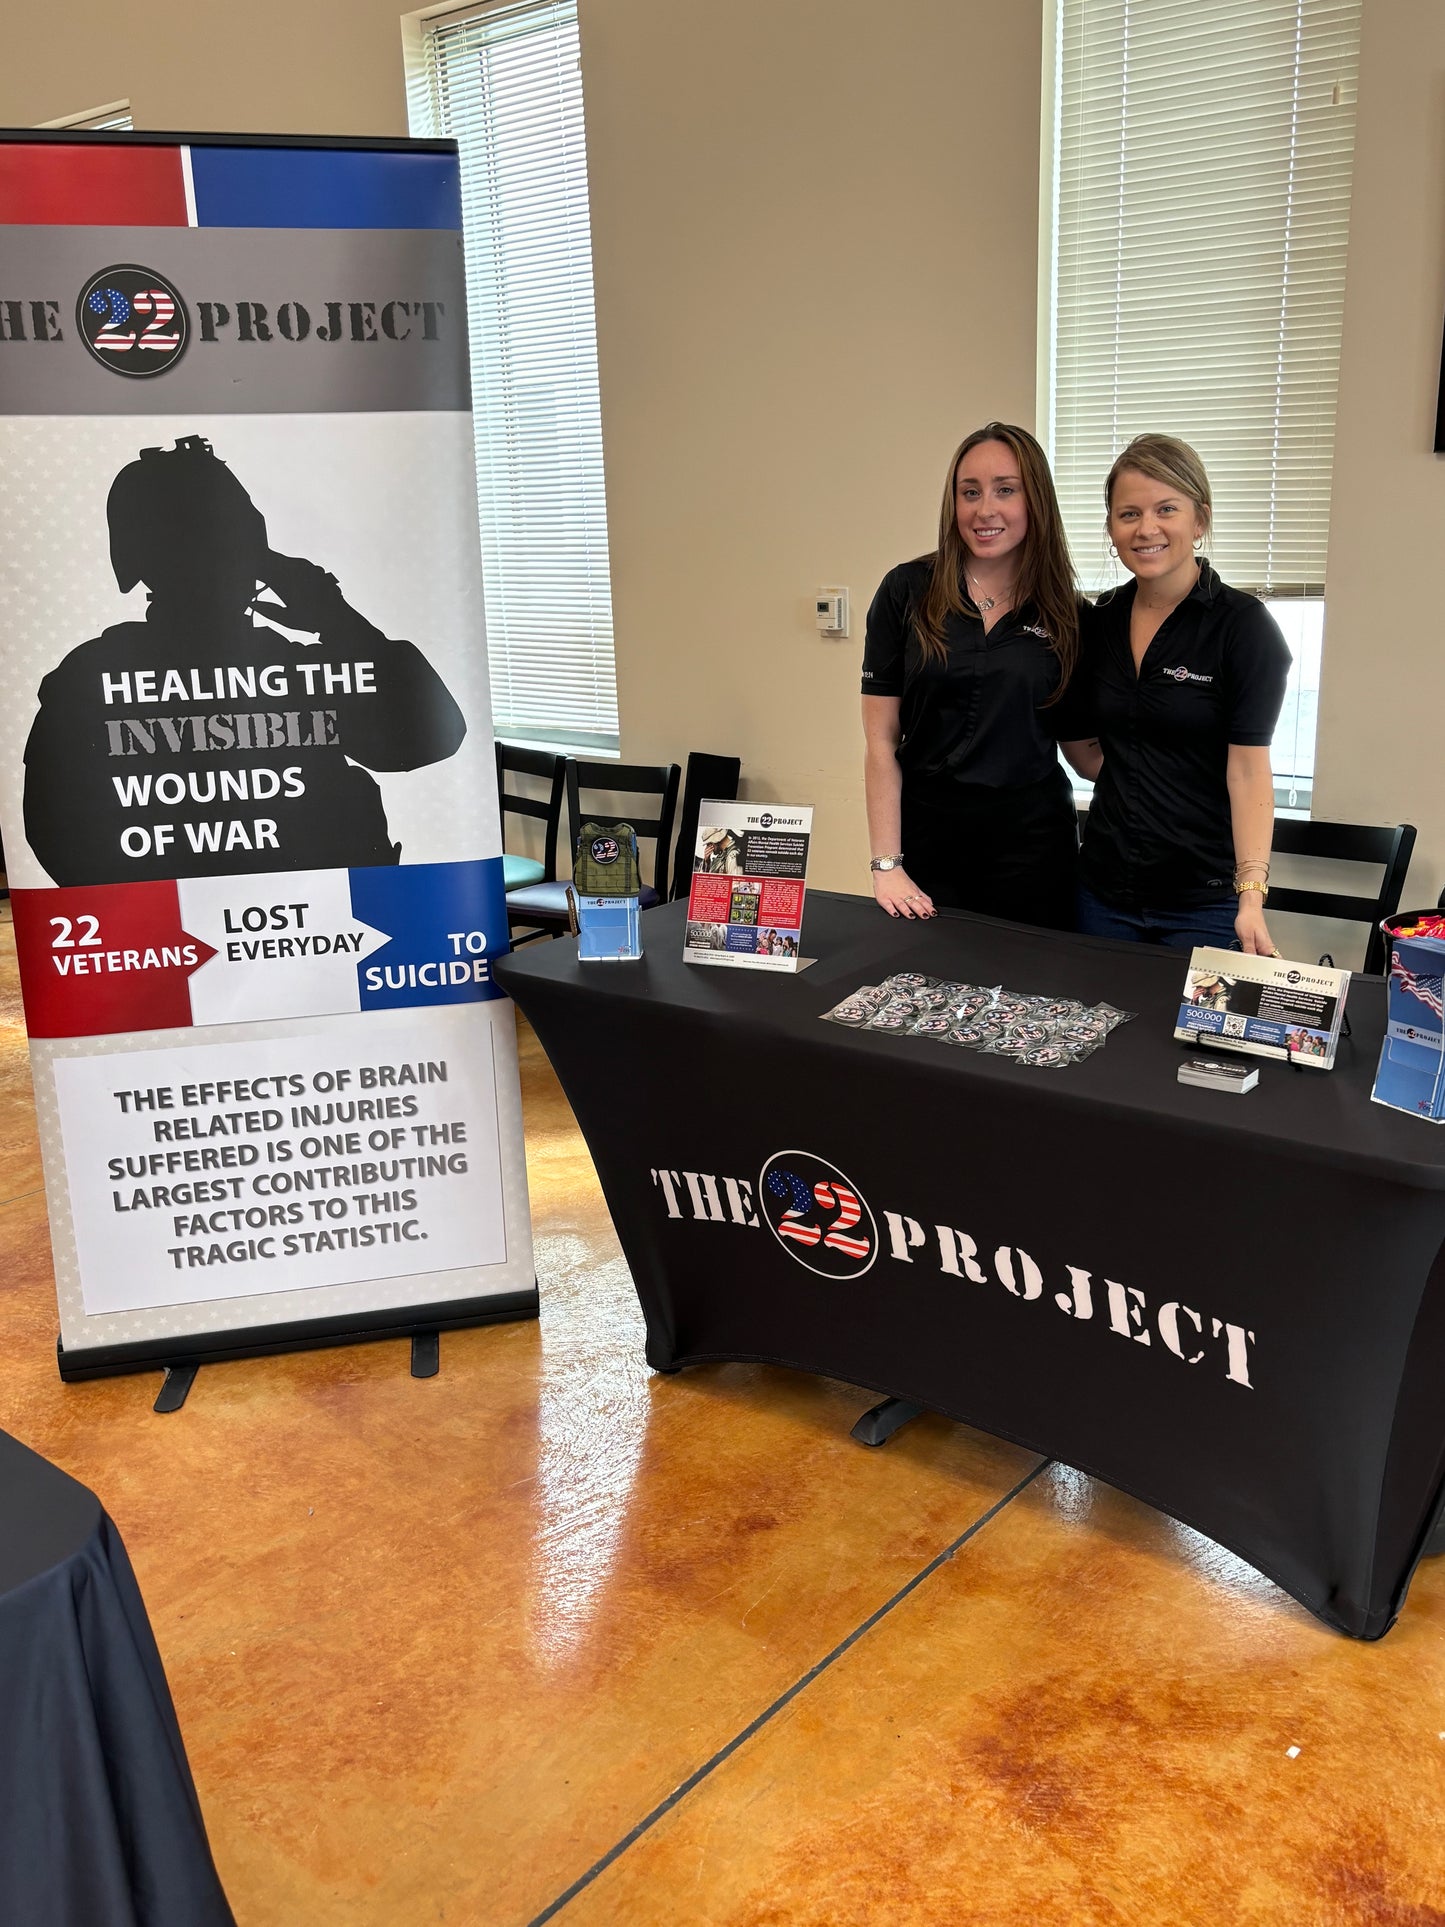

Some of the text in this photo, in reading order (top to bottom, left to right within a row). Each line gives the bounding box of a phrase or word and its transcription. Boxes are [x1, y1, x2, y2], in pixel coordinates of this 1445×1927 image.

[0, 288, 445, 352] HE 22 PROJECT
[101, 662, 377, 704] HEALING THE
[1187, 672, 1213, 682] PROJECT
[105, 710, 340, 756] INVISIBLE
[112, 766, 306, 808] WOUNDS
[120, 819, 280, 857] OF WAR
[761, 816, 772, 825] 22
[49, 914, 102, 948] 22
[223, 903, 310, 933] LOST
[52, 944, 199, 976] VETERANS
[226, 933, 364, 962] EVERYDAY
[447, 931, 487, 955] TO
[366, 960, 490, 991] SUICIDE
[1273, 971, 1334, 987] THE 22 PROJECT
[1186, 1009, 1222, 1022] 500,000
[114, 1060, 448, 1113] THE EFFECTS OF BRAIN
[153, 1094, 419, 1142] RELATED INJURIES
[108, 1121, 467, 1181] SUFFERED IS ONE OF THE
[112, 1151, 468, 1212] LARGEST CONTRIBUTING
[173, 1188, 418, 1237] FACTORS TO THIS
[168, 1219, 429, 1269] TRAGIC STATISTIC.
[650, 1167, 1256, 1390] THE 22 PROJECT
